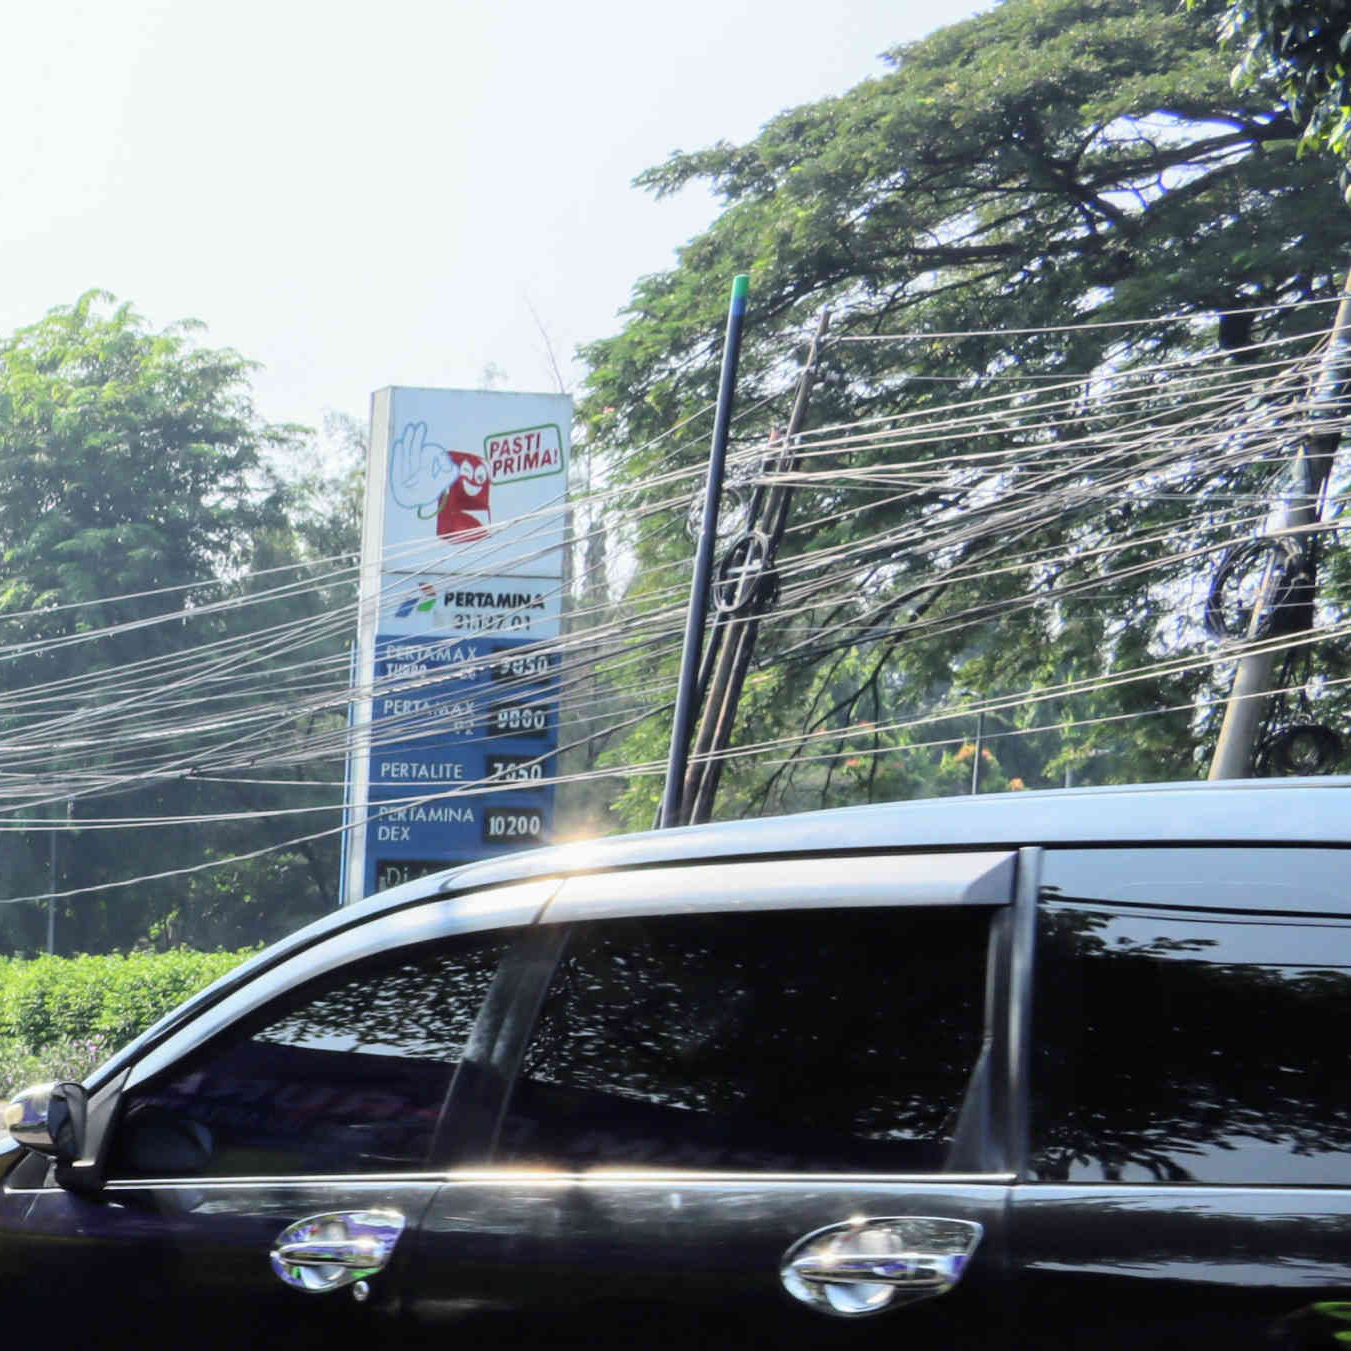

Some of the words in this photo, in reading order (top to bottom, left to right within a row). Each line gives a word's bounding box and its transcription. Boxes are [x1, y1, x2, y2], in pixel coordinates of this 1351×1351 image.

[489, 432, 541, 460] PASTI
[493, 449, 558, 478] PRIMA!
[444, 592, 546, 609] PERTAMINA
[380, 762, 463, 779] PERTALITE
[378, 806, 475, 822] PERTAMINA
[378, 826, 411, 841] DEX
[489, 815, 540, 835] 10200
